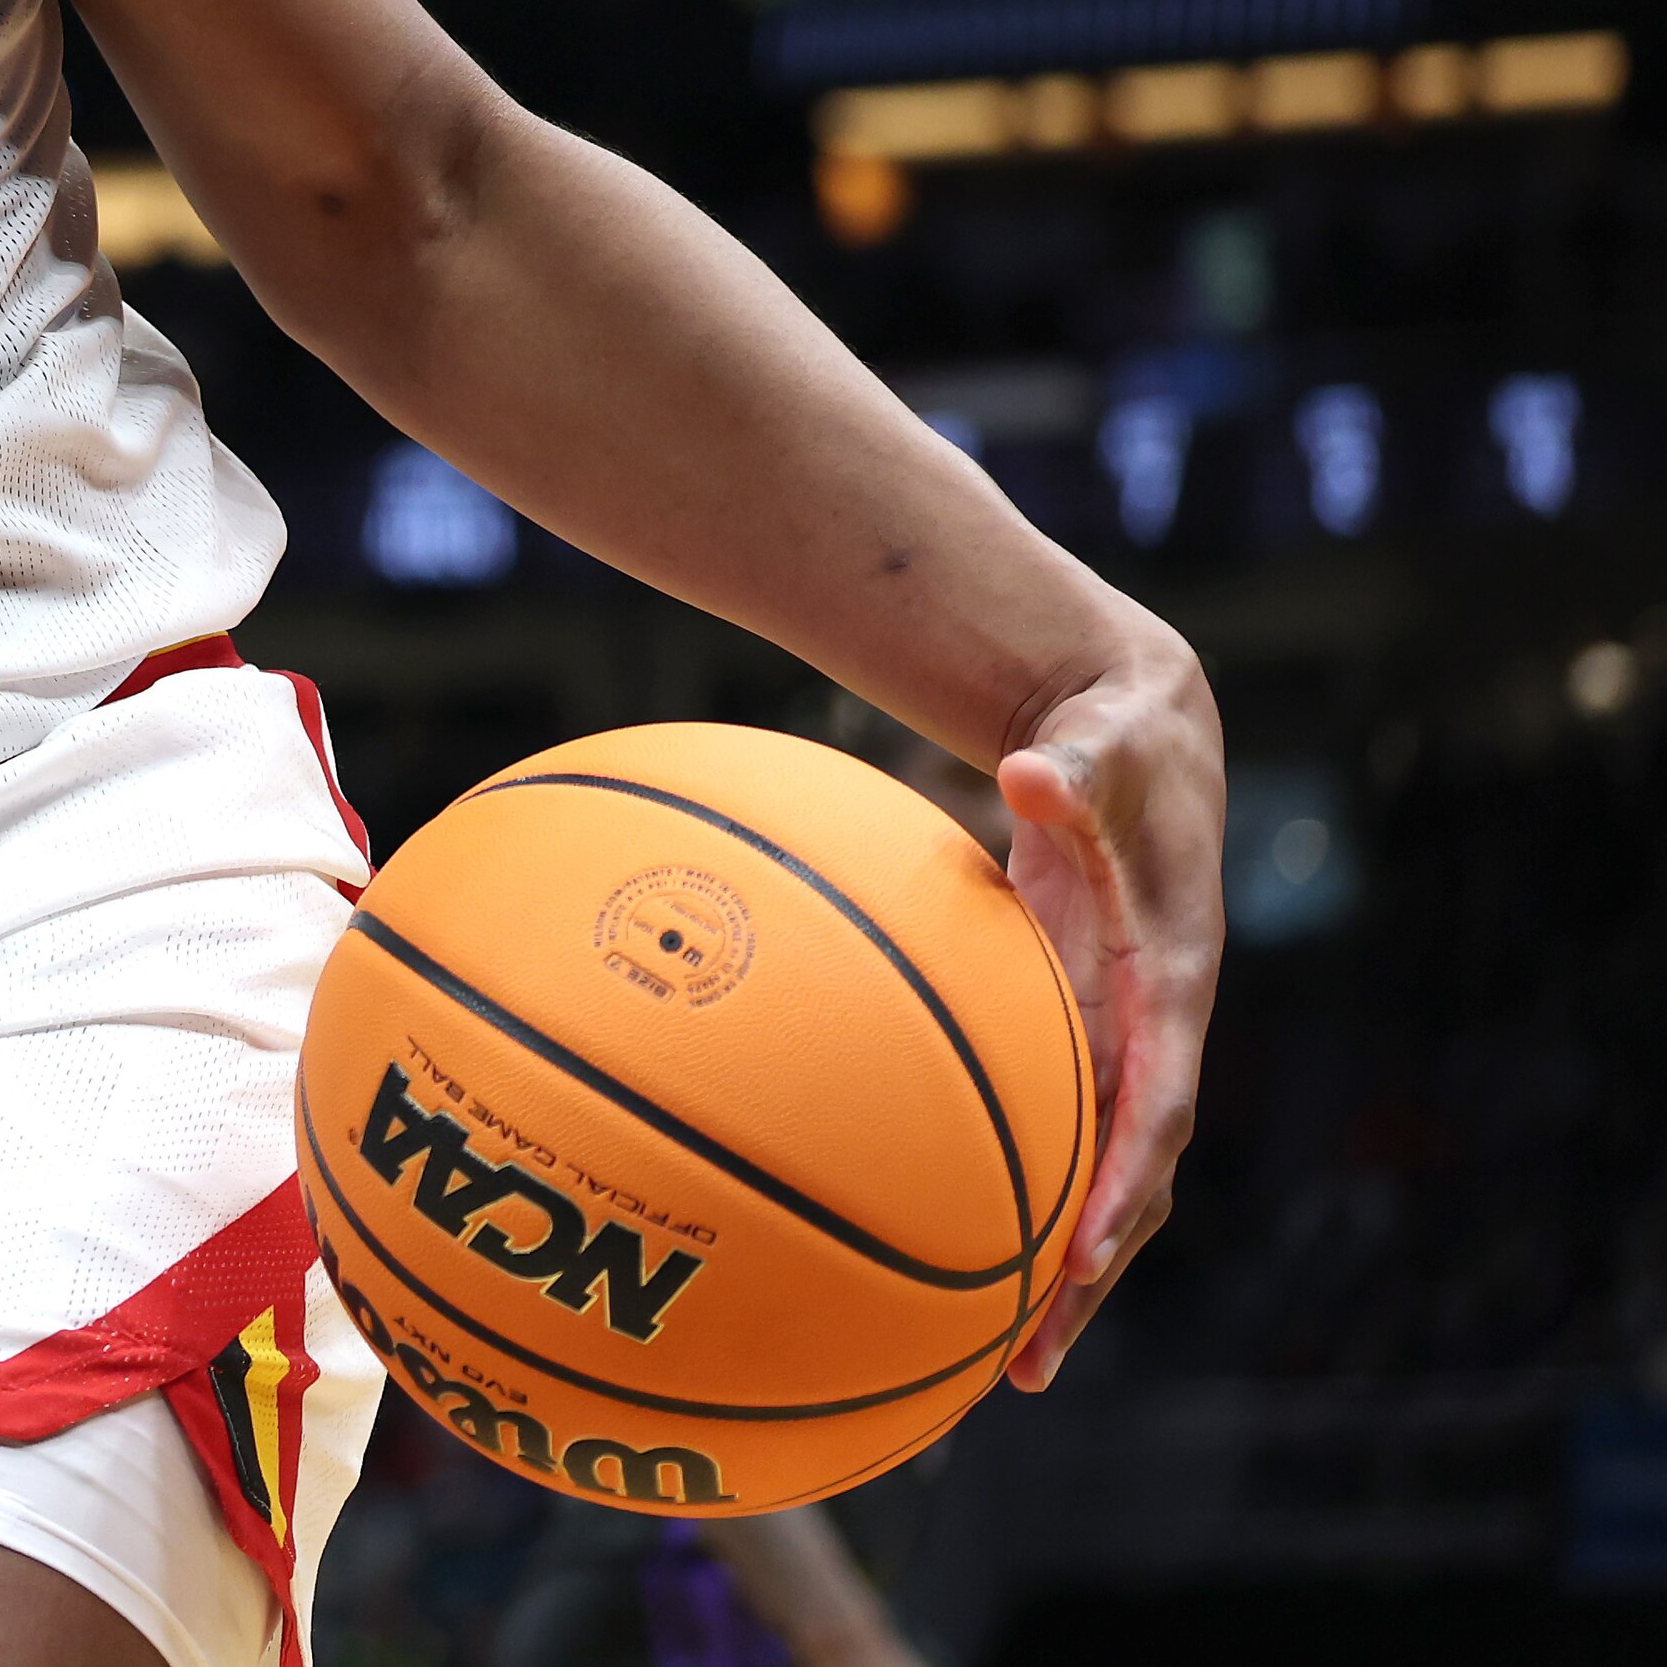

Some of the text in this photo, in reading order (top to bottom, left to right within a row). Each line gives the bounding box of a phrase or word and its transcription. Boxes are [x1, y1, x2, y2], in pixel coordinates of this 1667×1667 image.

[358, 1060, 705, 1345] NCAA
[407, 1034, 716, 1246] OFFICIAL GAME BALL
[394, 1317, 528, 1405] EVO NXT
